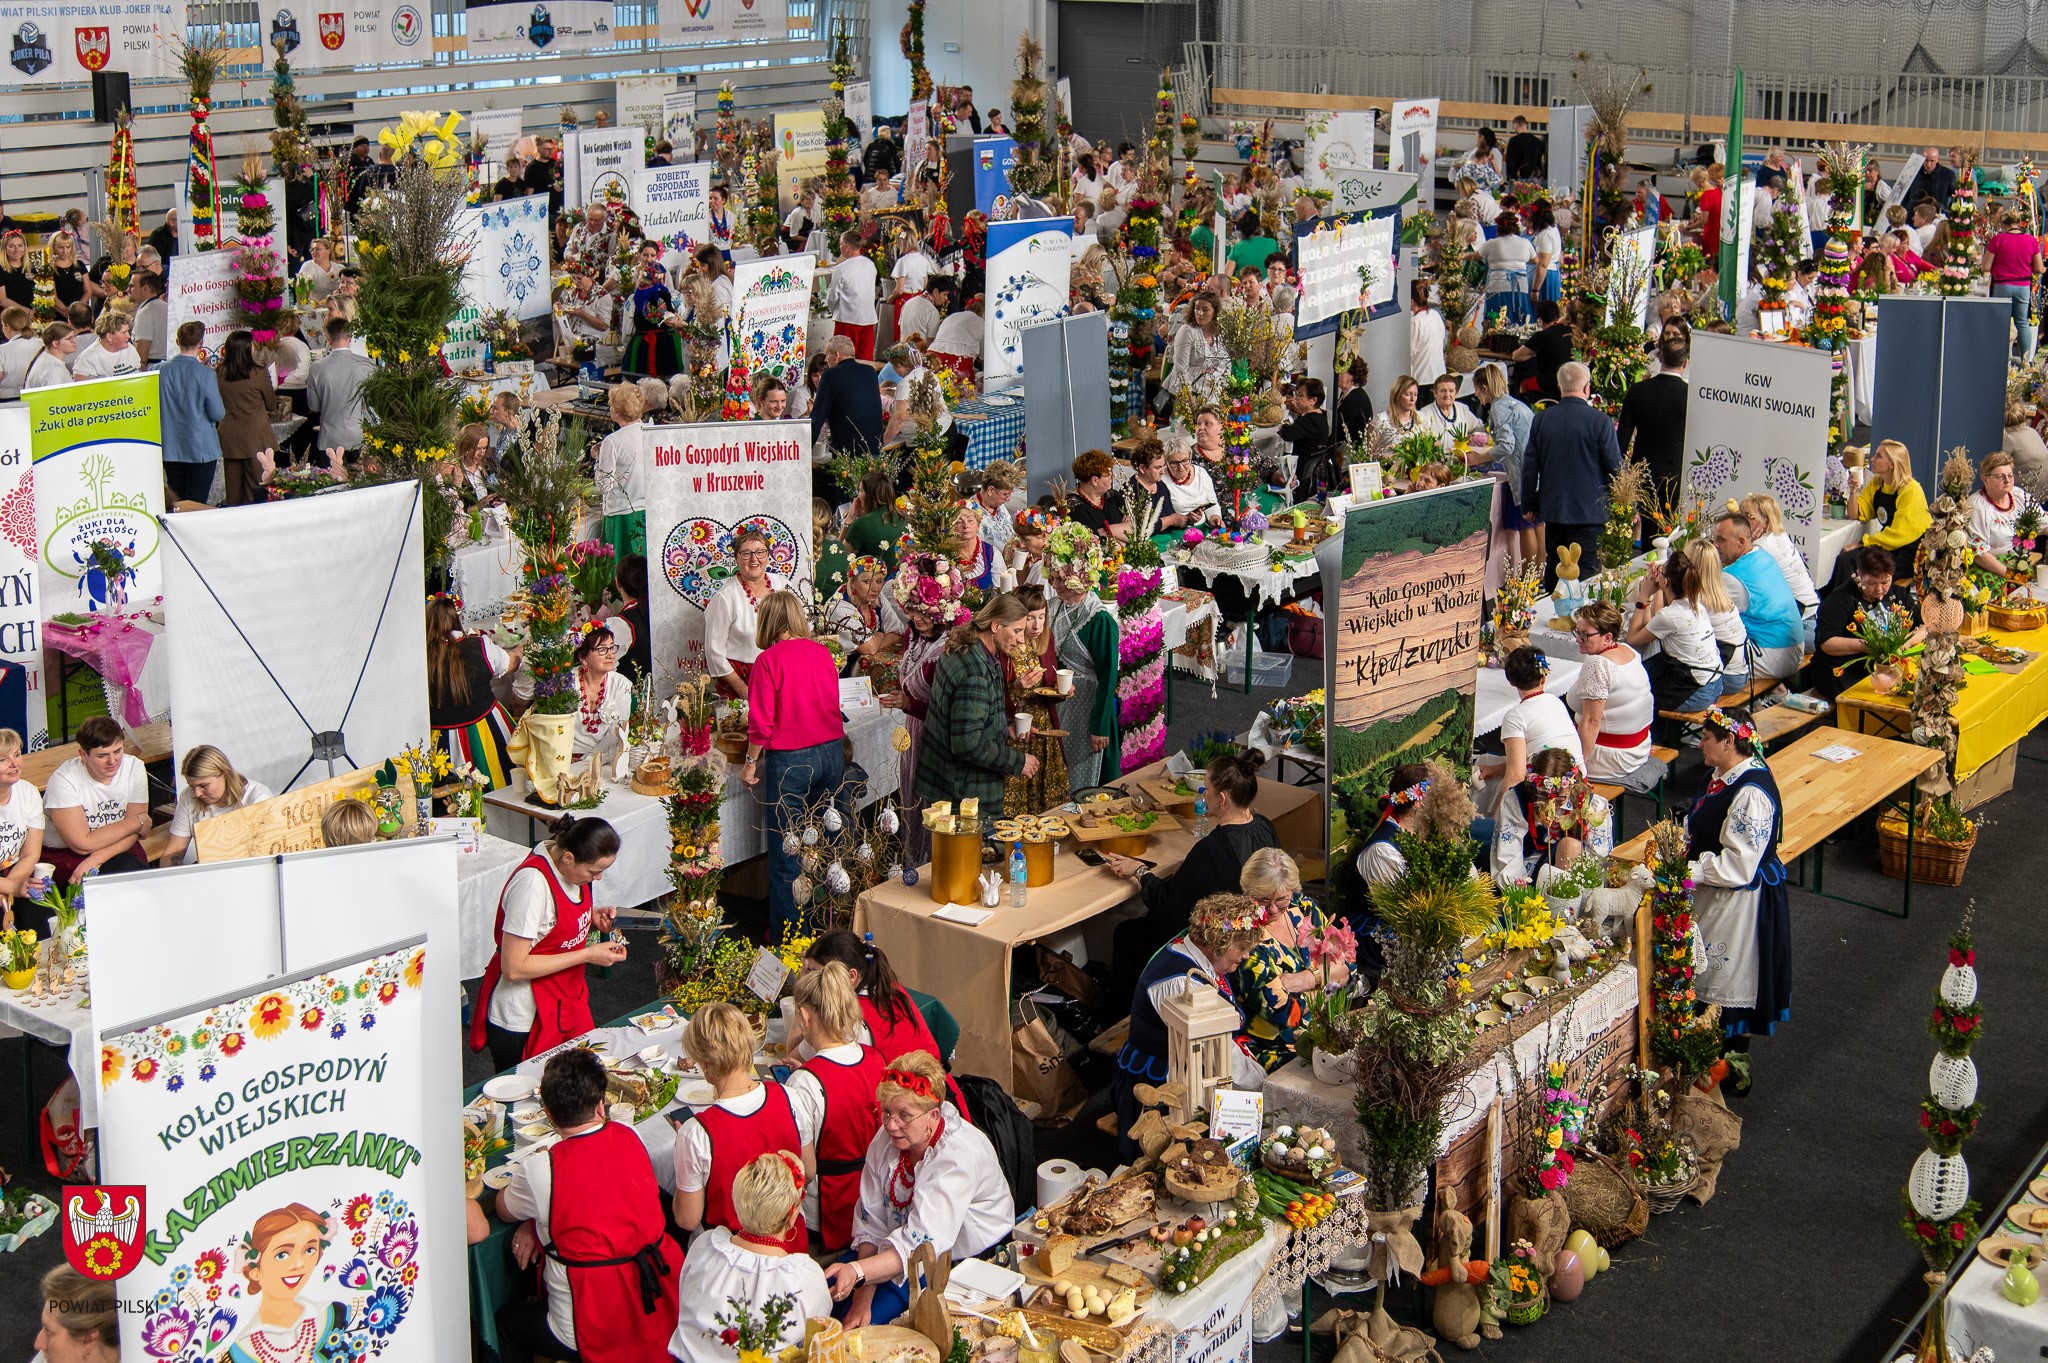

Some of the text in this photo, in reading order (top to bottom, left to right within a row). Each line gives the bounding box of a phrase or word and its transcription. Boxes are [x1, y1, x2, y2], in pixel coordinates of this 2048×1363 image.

[26, 7, 57, 16] PILSKI
[59, 6, 97, 16] WSPIERA
[100, 6, 121, 14] KLUB
[124, 4, 150, 14] JOKER
[154, 4, 172, 14] PIŁA
[354, 11, 380, 19] POWIAT
[12, 49, 50, 60] JOKER PIŁA
[124, 41, 150, 50] PILSKI
[656, 170, 690, 182] KOBIETY
[647, 180, 700, 192] GOSPODARNE
[652, 189, 700, 202] WYJĄTKOWE
[180, 282, 203, 295] Koło
[1021, 304, 1040, 314] KGW
[1745, 372, 1772, 389] KGW
[48, 396, 134, 416] Stowarzyszenie
[1699, 386, 1815, 418] CEKOWIAKI SWOJAKI
[68, 417, 84, 428] dla
[86, 406, 152, 426] przyszłości”
[656, 440, 800, 466] Koło Gospodyń Wiejskich
[693, 470, 764, 493] w Kruszewie
[72, 510, 135, 527] STOWARZYSZENIE
[78, 520, 102, 532] ŻUKI
[71, 526, 138, 544] PRZYSZŁOŚCI
[1402, 569, 1465, 604] Gospodyń
[1345, 589, 1479, 634] Wiejskich w Kłodzie
[578, 906, 592, 932] KGW
[158, 1053, 389, 1152] KOŁO GOSPODYŃ
[199, 1089, 346, 1156] WIEJSKICH
[1203, 1304, 1228, 1332] KGW
[1186, 1317, 1244, 1363] Kownatki
